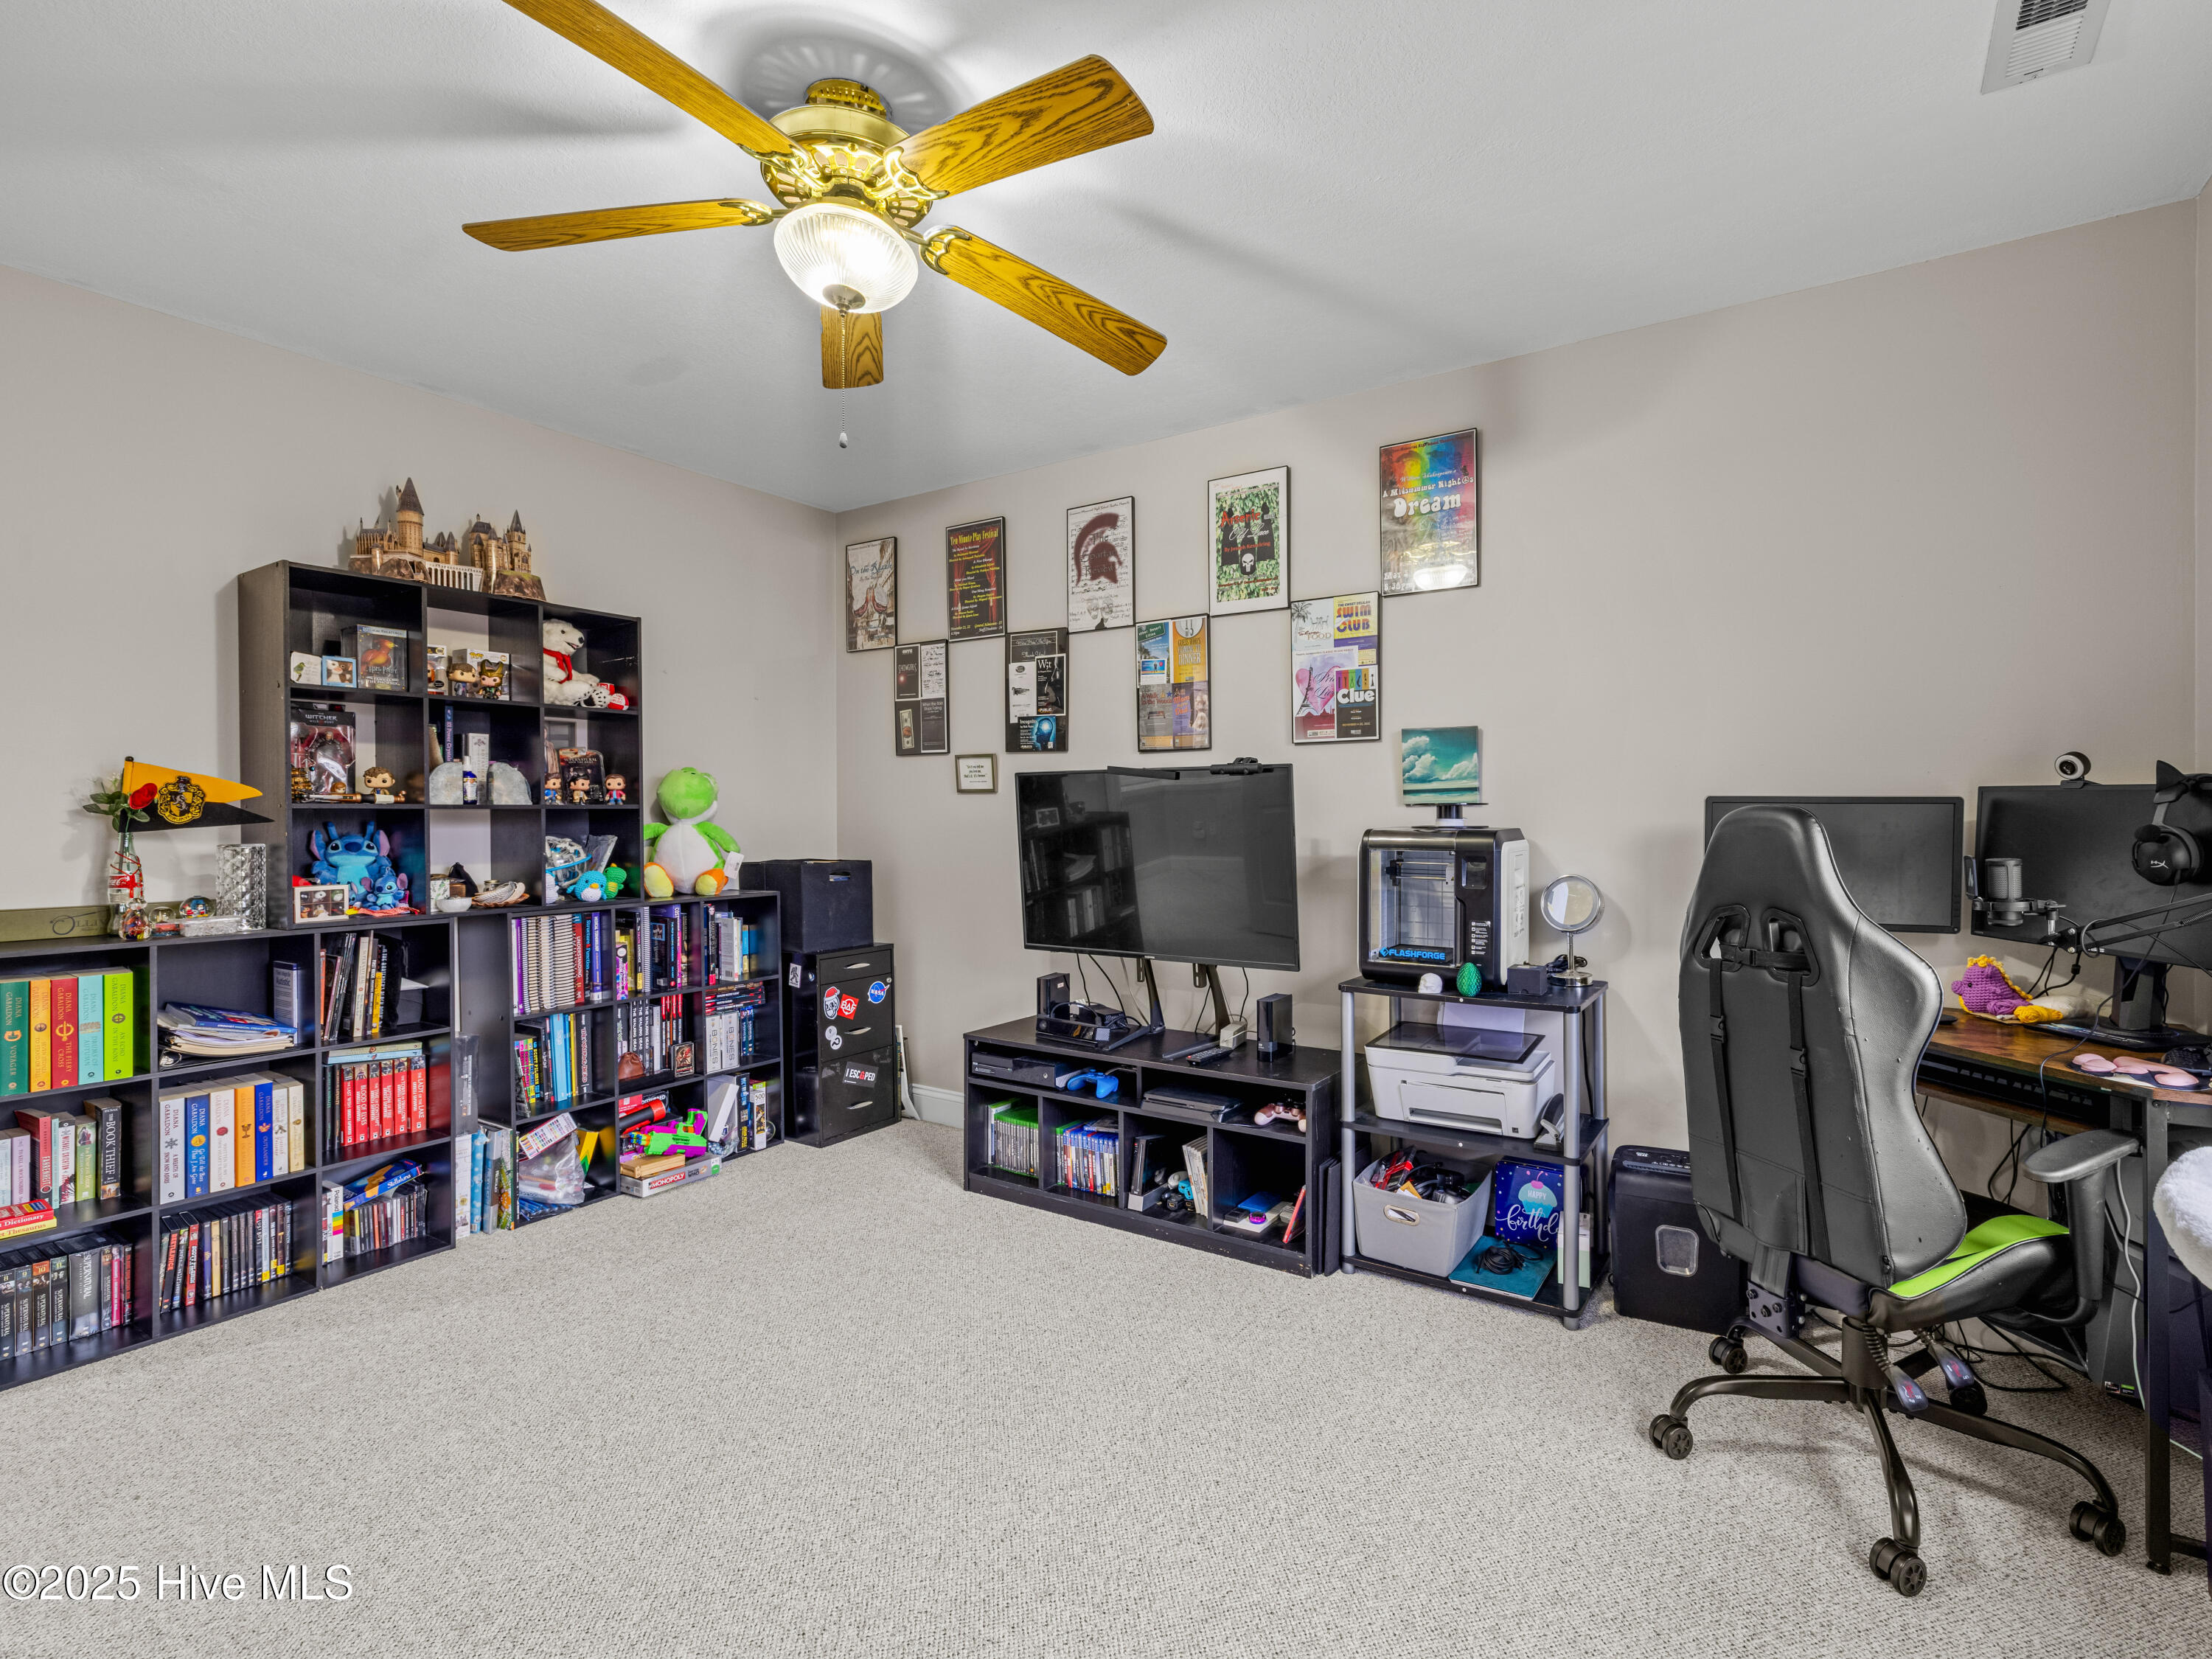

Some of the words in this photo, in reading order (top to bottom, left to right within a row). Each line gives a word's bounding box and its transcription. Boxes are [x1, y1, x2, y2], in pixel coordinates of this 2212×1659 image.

[1391, 483, 1436, 496] Midsummer
[1394, 493, 1461, 517] Dream
[1221, 509, 1261, 527] Arsenic
[959, 535, 972, 543] Minute
[983, 528, 998, 539] Festival
[1091, 529, 1108, 545] The
[1229, 526, 1249, 540] Old
[1247, 523, 1269, 538] Lace
[1337, 605, 1371, 618] SWIM
[1337, 618, 1369, 633] CLUB
[1178, 653, 1201, 666] DINNER
[1338, 688, 1374, 703] Clue
[1388, 949, 1445, 960] FLASHFORGE
[846, 1068, 849, 1077] I
[755, 1092, 765, 1100] 500
[105, 1121, 116, 1147] BOOK
[105, 1147, 116, 1175] THIEF
[41, 1156, 51, 1186] FAHRENHEIT
[189, 1173, 198, 1185] Gone
[387, 1174, 411, 1188] Stellaluna
[651, 1173, 685, 1188] MONOPOLY
[1528, 1190, 1547, 1200] HAPPY
[4, 1214, 44, 1227] Dictionary
[7, 1224, 46, 1236] Thesaurus
[167, 1233, 178, 1271] BEETLEJUICE
